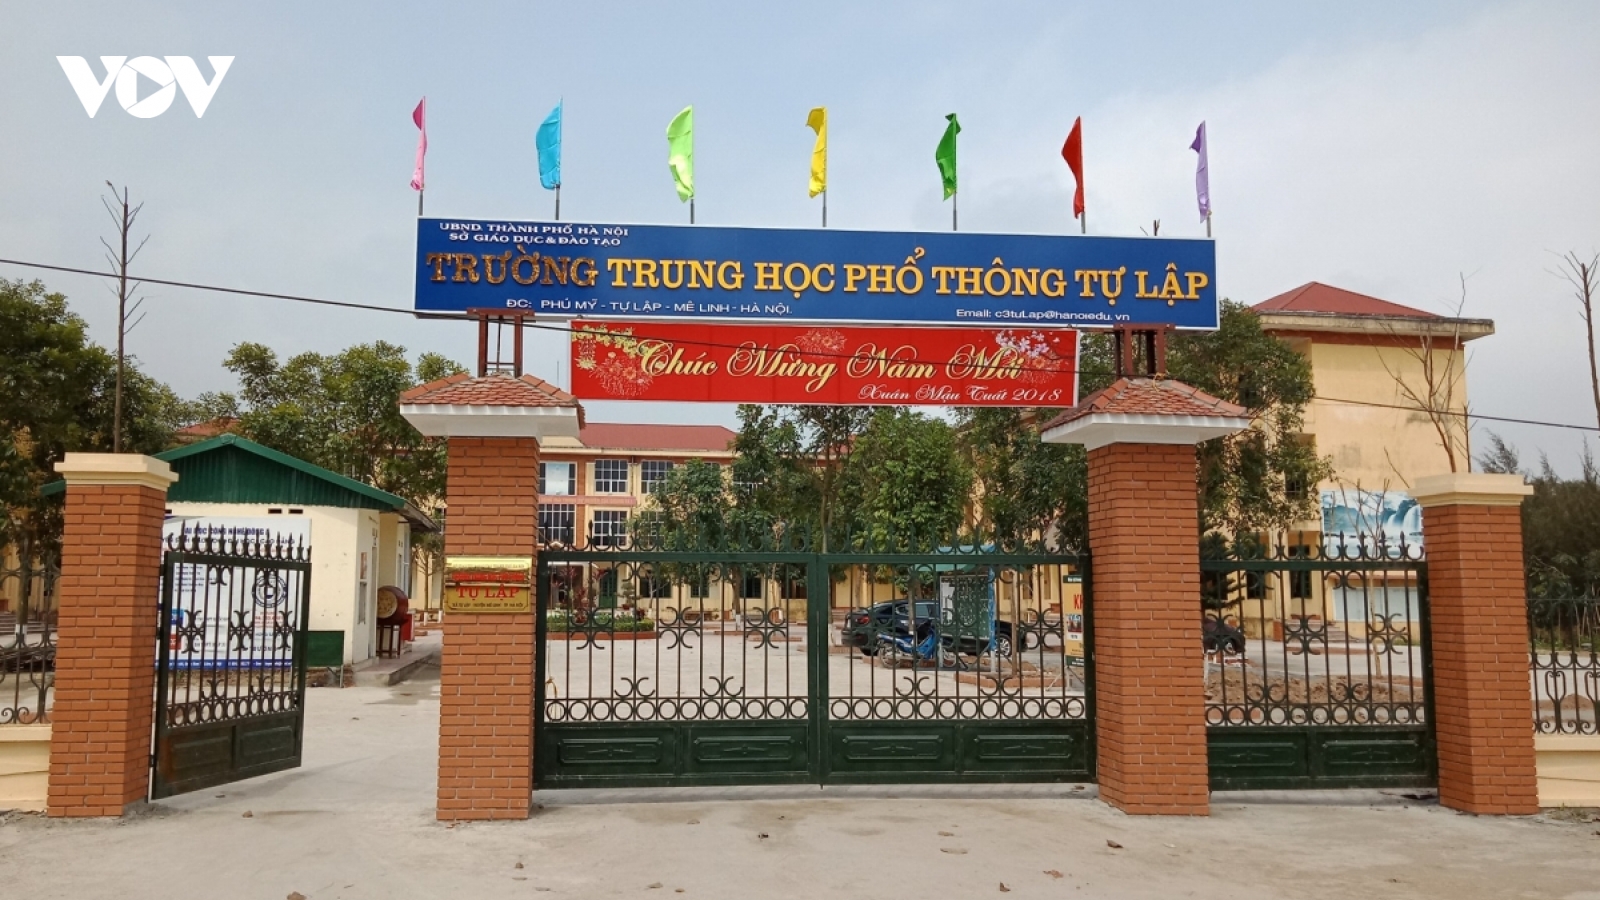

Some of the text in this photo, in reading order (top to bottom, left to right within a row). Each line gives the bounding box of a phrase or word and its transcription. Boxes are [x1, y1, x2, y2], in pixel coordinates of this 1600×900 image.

[487, 222, 538, 233] THÀNH
[577, 225, 599, 235] HÀ
[603, 226, 629, 237] NỘI
[473, 232, 510, 243] GIÁO
[591, 237, 621, 247] TẠO
[426, 244, 1209, 306] TRƯỜNG TRUNG HỌC PHỔ THÔNG TỰ LẬP
[506, 298, 532, 309] ĐC:
[541, 298, 572, 310] PHÚ
[575, 298, 598, 310] MỸ
[609, 301, 631, 313] TỰ
[633, 300, 662, 313] LẬP
[674, 301, 696, 313] MÊ
[699, 303, 730, 313] LINH
[740, 302, 761, 314] HÀ
[956, 308, 992, 318] Email:
[636, 339, 718, 377] Chúc
[726, 341, 838, 393] Mừng
[858, 383, 1063, 403] Xuân Mậu Tuất 2018
[484, 583, 520, 601] LẬP
